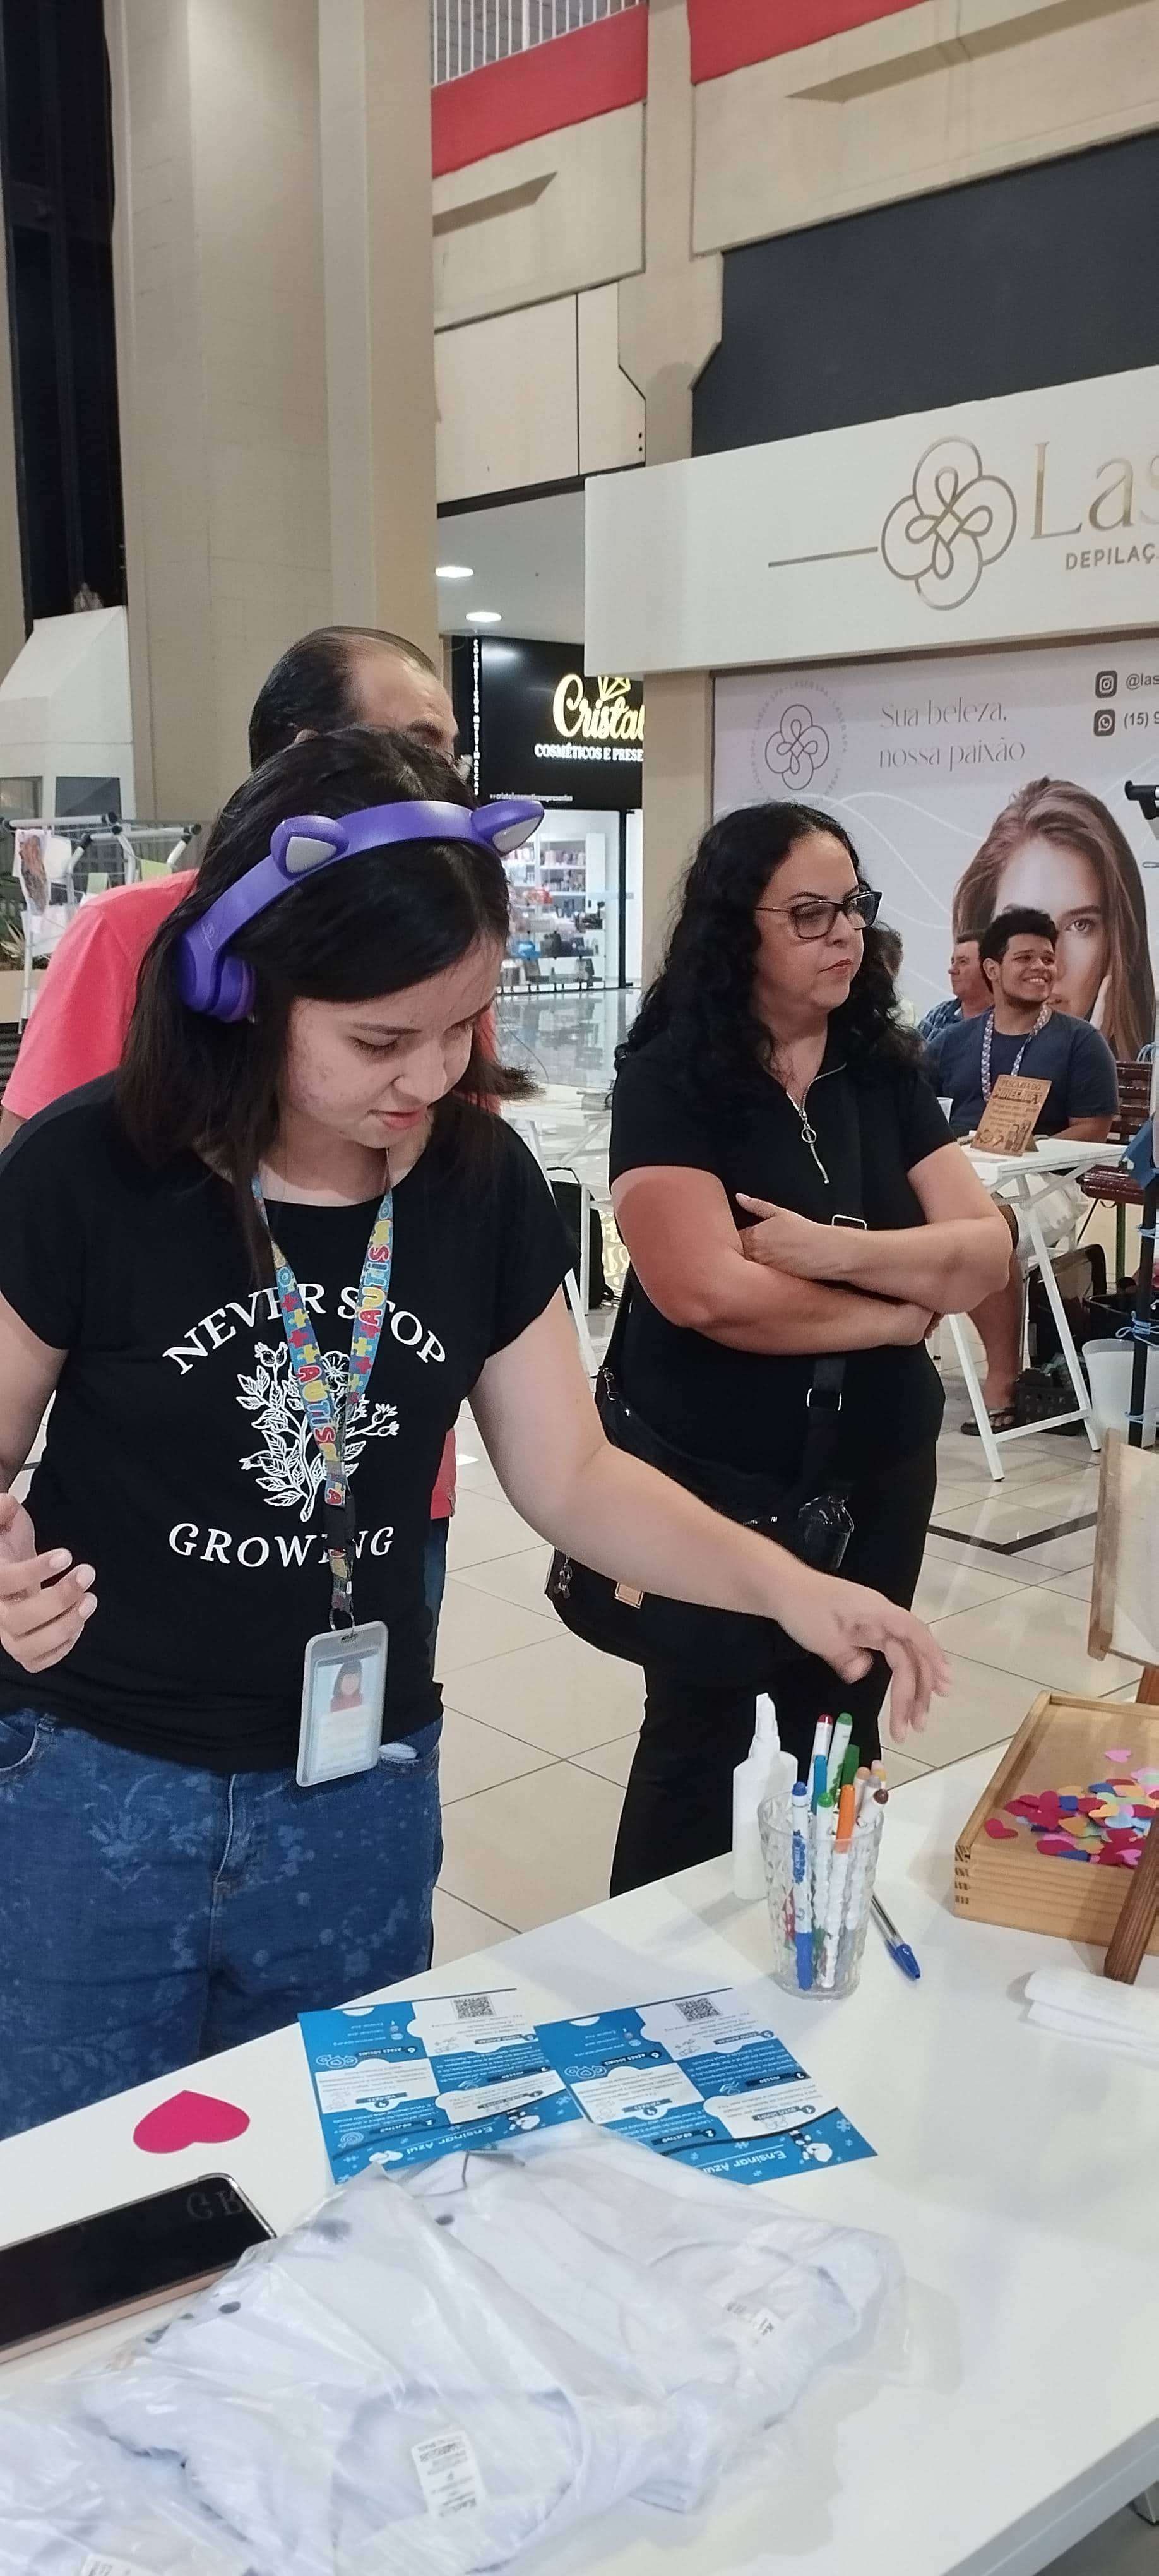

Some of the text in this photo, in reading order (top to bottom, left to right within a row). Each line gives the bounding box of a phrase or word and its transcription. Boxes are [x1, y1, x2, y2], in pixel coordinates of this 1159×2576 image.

[553, 673, 645, 741] Cristal
[881, 702, 918, 727] Sua
[1124, 712, 1149, 729] (15)
[534, 742, 602, 760] COSMÉTICOS
[603, 746, 612, 761] E
[880, 737, 1025, 772] nossa paixão
[336, 1285, 446, 1364] SOP
[406, 2126, 494, 2154] Ensinar Azul
[734, 2150, 787, 2168] Ensinar
